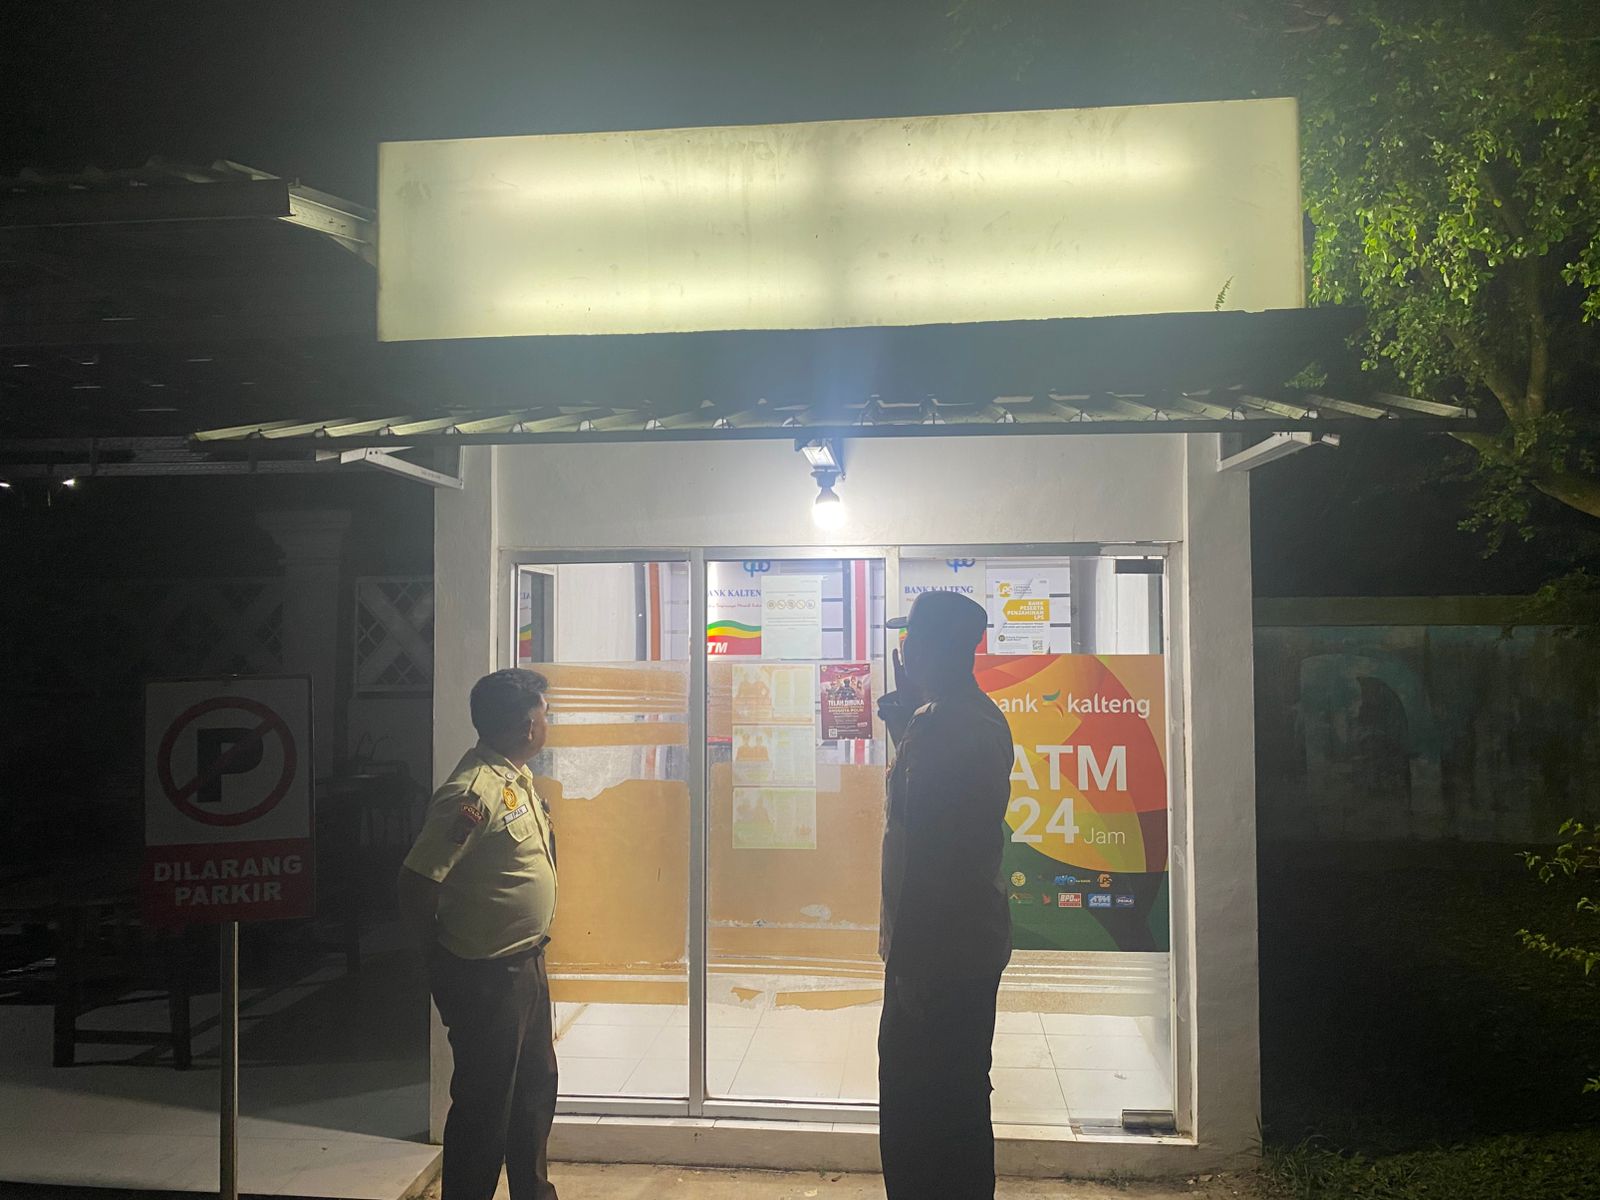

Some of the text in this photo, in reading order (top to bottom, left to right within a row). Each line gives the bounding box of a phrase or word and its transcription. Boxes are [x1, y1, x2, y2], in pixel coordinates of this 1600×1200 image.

[708, 589, 761, 597] ANK KALTEN
[904, 586, 928, 594] BANK
[707, 642, 728, 653] TM
[988, 692, 1151, 719] ank kalteng
[197, 728, 264, 803] P
[1009, 744, 1128, 792] ATM
[1010, 796, 1126, 845] 24 Jam
[153, 855, 303, 882] DILARANG
[175, 881, 283, 906] PARKIR
